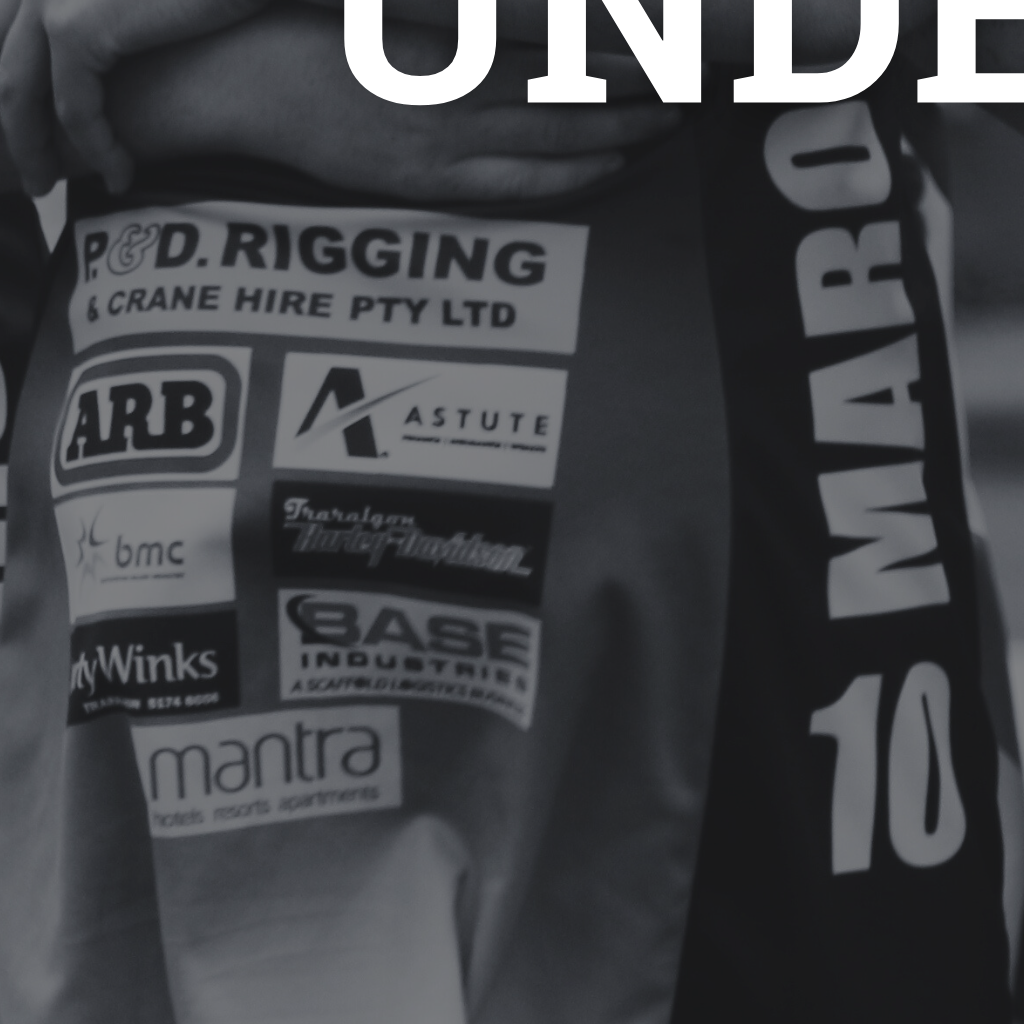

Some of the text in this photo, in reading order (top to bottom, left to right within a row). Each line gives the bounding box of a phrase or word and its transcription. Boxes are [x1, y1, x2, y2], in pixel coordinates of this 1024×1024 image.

[221, 222, 548, 287] RIGGING
[107, 285, 222, 317] CRANE
[233, 286, 335, 319] HIRE
[349, 296, 431, 325] PTY
[440, 300, 518, 328] LTD
[65, 380, 216, 463] ARB
[404, 405, 550, 437] ASTUTE
[115, 534, 185, 569] bmc
[297, 600, 531, 668] BASE
[301, 651, 527, 693] INDUSTRIES
[149, 721, 382, 802] mantra
[809, 661, 967, 875] 10
